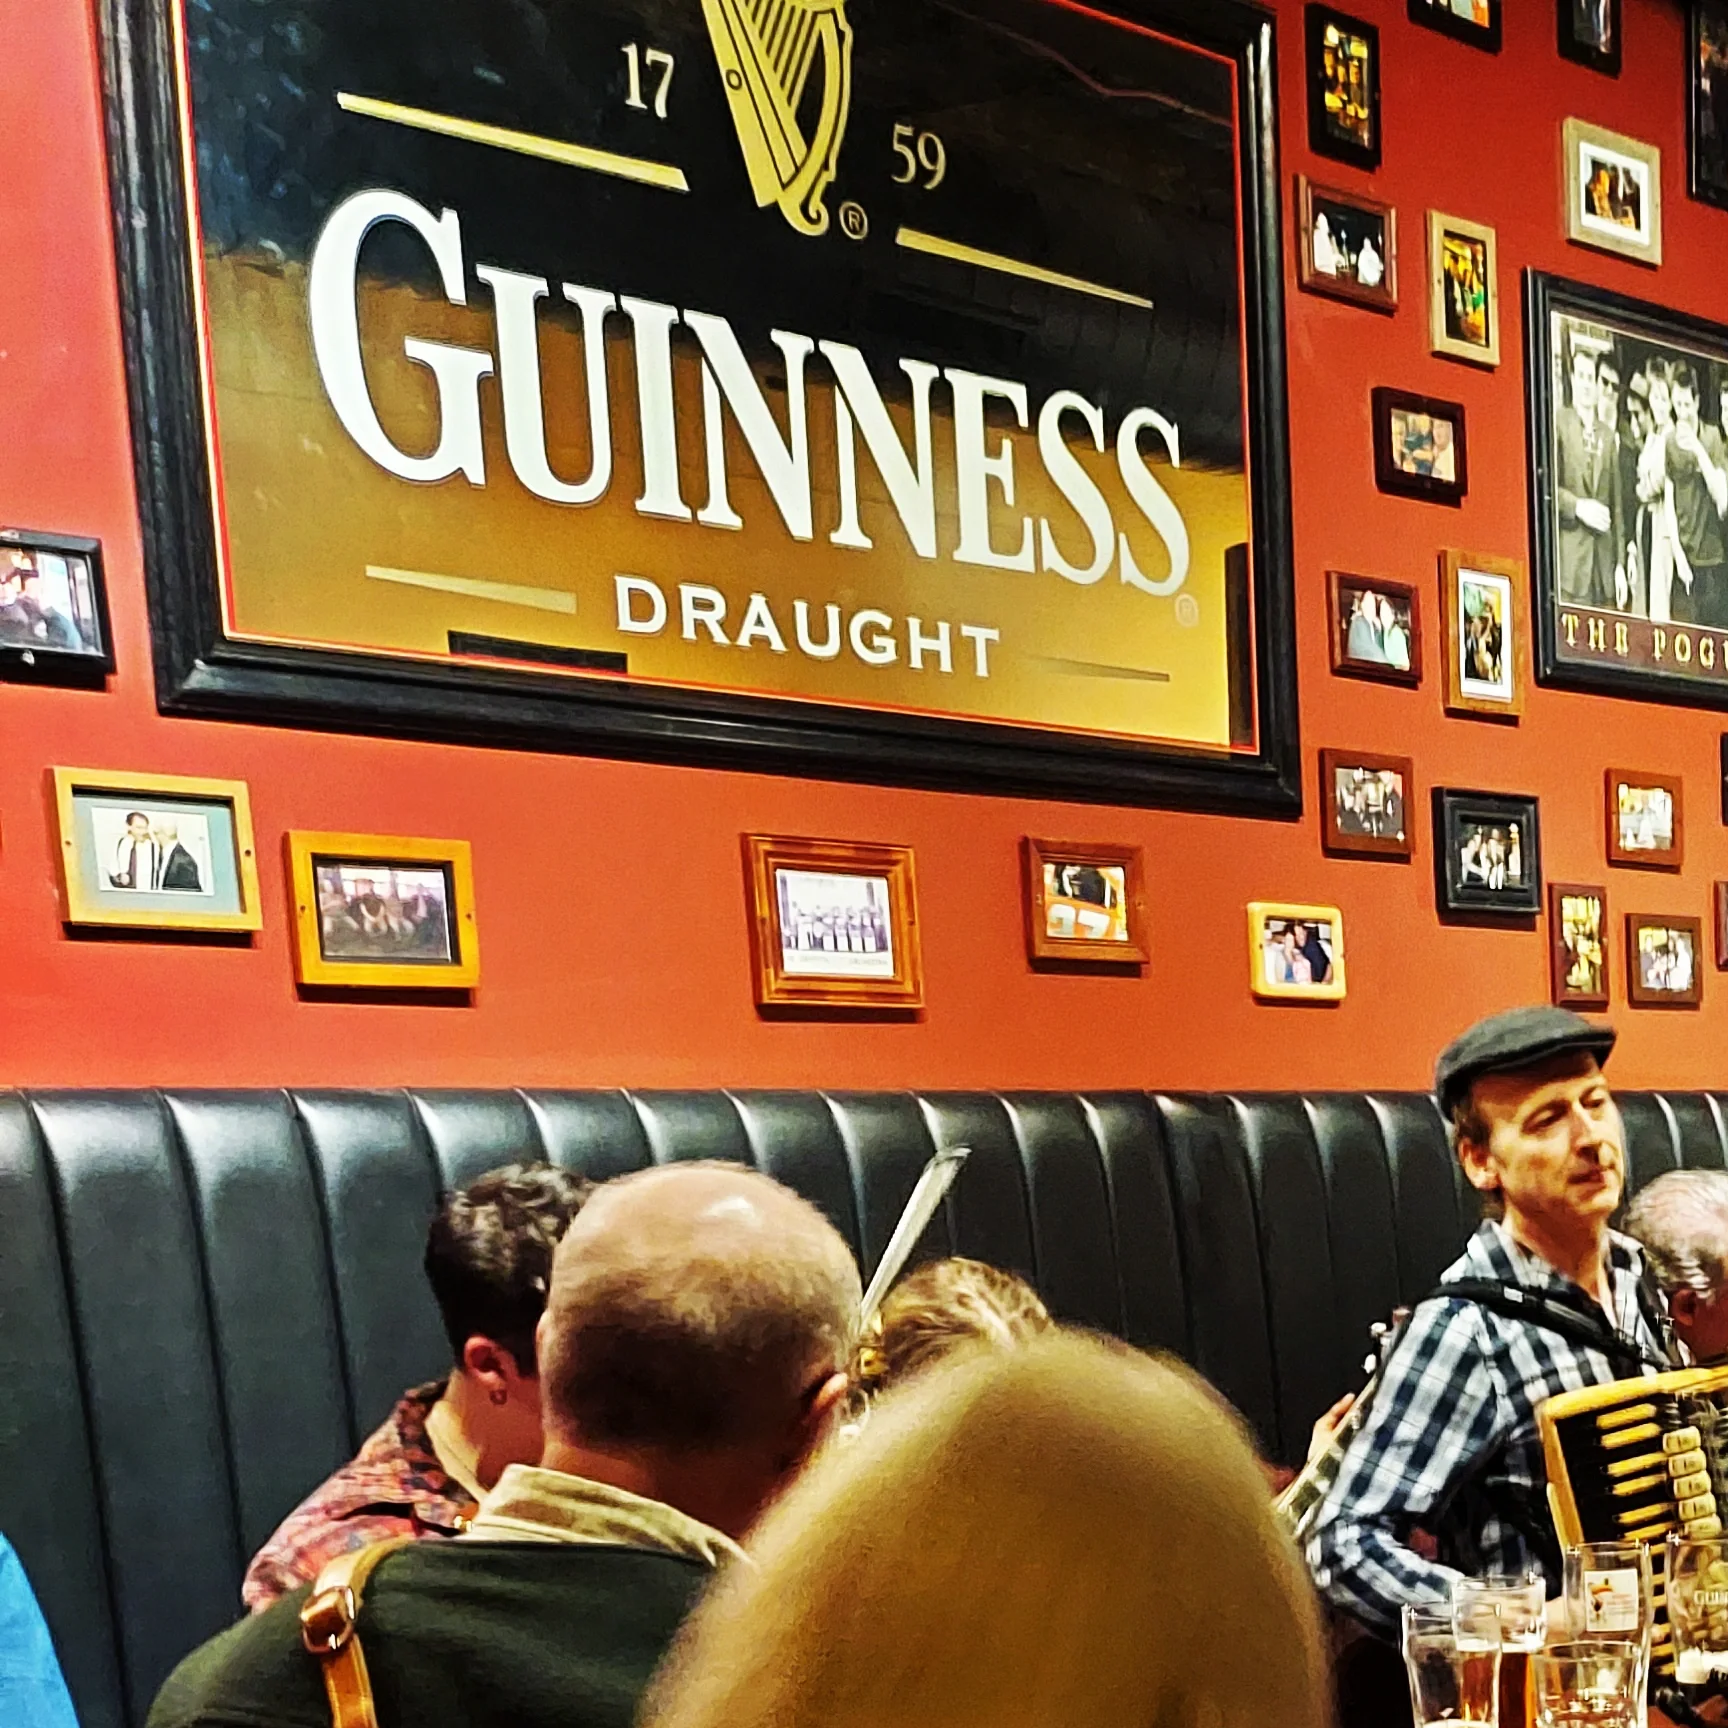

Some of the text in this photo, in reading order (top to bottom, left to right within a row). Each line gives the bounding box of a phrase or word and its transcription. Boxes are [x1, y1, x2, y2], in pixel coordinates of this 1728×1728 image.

[620, 41, 947, 191] 17 59
[307, 187, 1191, 597] GUINNESS
[613, 573, 1001, 679] DRAUGHT
[1561, 612, 1629, 658] THE
